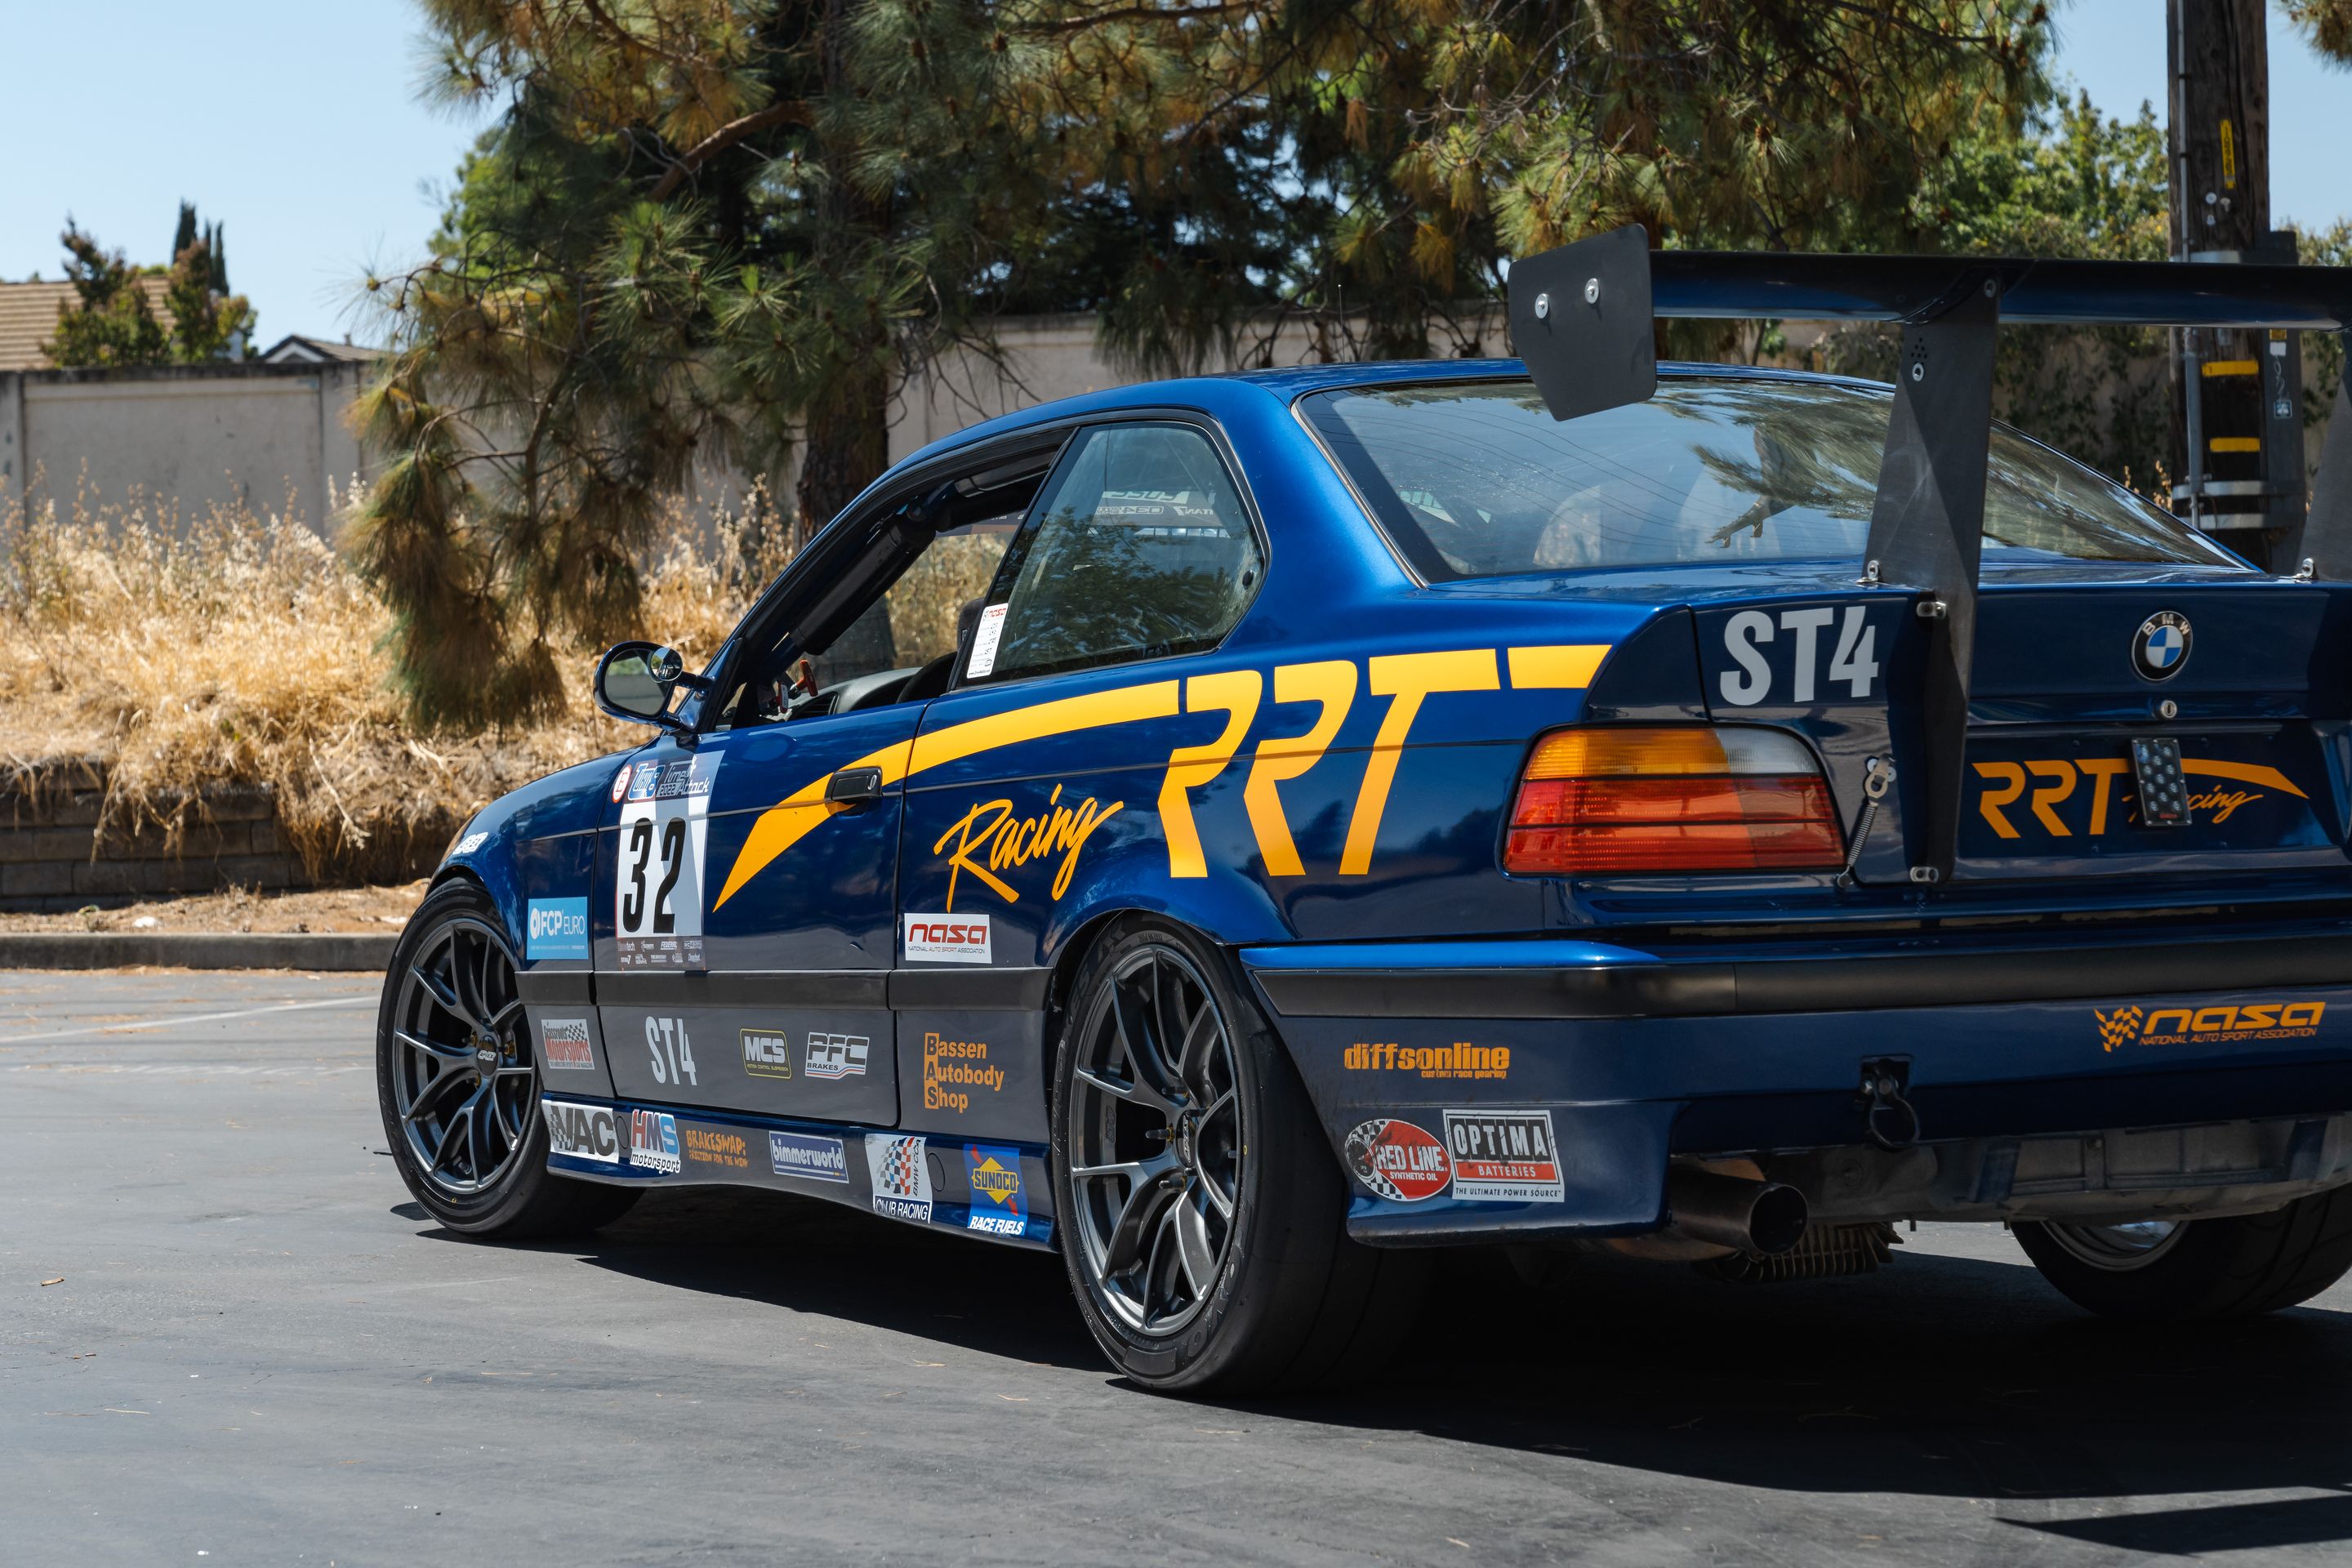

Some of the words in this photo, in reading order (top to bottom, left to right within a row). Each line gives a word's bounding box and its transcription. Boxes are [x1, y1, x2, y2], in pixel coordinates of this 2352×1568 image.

[2142, 613, 2190, 636] BMW
[1720, 605, 1879, 706] ST4
[1157, 648, 1501, 878] RRT
[660, 784, 676, 796] 2022
[1971, 758, 2128, 839] RRT
[933, 783, 1125, 914] Racing
[622, 817, 686, 934] 32
[541, 910, 563, 936] FCP
[564, 915, 586, 935] EURO
[909, 924, 987, 944] nasa
[2143, 1001, 2326, 1035] nasa
[808, 1032, 869, 1065] PFC
[927, 1036, 987, 1058] Bassen
[2138, 1034, 2187, 1045] NATIONAL
[2190, 1032, 2221, 1043] AUTO
[2220, 1031, 2255, 1041] SPORT
[2254, 1027, 2318, 1040] ASSOCIATION
[546, 1036, 592, 1066] Motorsports
[645, 1016, 697, 1085] ST4
[745, 1036, 786, 1064] MCS
[1344, 1042, 1510, 1070] diffsonline
[807, 1062, 839, 1071] BRAKES
[926, 1061, 1004, 1091] Autobody
[1421, 1070, 1451, 1078] custom
[1453, 1070, 1472, 1078] race
[1474, 1070, 1507, 1080] gearing
[927, 1086, 969, 1113] Shop
[631, 1110, 679, 1156] HMS
[1453, 1124, 1548, 1157] OPTIMA
[630, 1153, 680, 1173] motorsport
[772, 1138, 844, 1169] bimmerworld
[913, 1139, 921, 1163] CCA
[1375, 1145, 1407, 1170] RED
[975, 1170, 1017, 1192] SUNOCO
[1389, 1171, 1425, 1181] SYNTHETIC
[1426, 1173, 1438, 1181] OIL
[1477, 1165, 1536, 1177] BATTERIES
[1469, 1187, 1500, 1196] ULTIMATE
[1503, 1188, 1527, 1196] POWER
[898, 1201, 929, 1220] RACING
[969, 1215, 996, 1232] RACE
[995, 1218, 1025, 1236] FUELS
